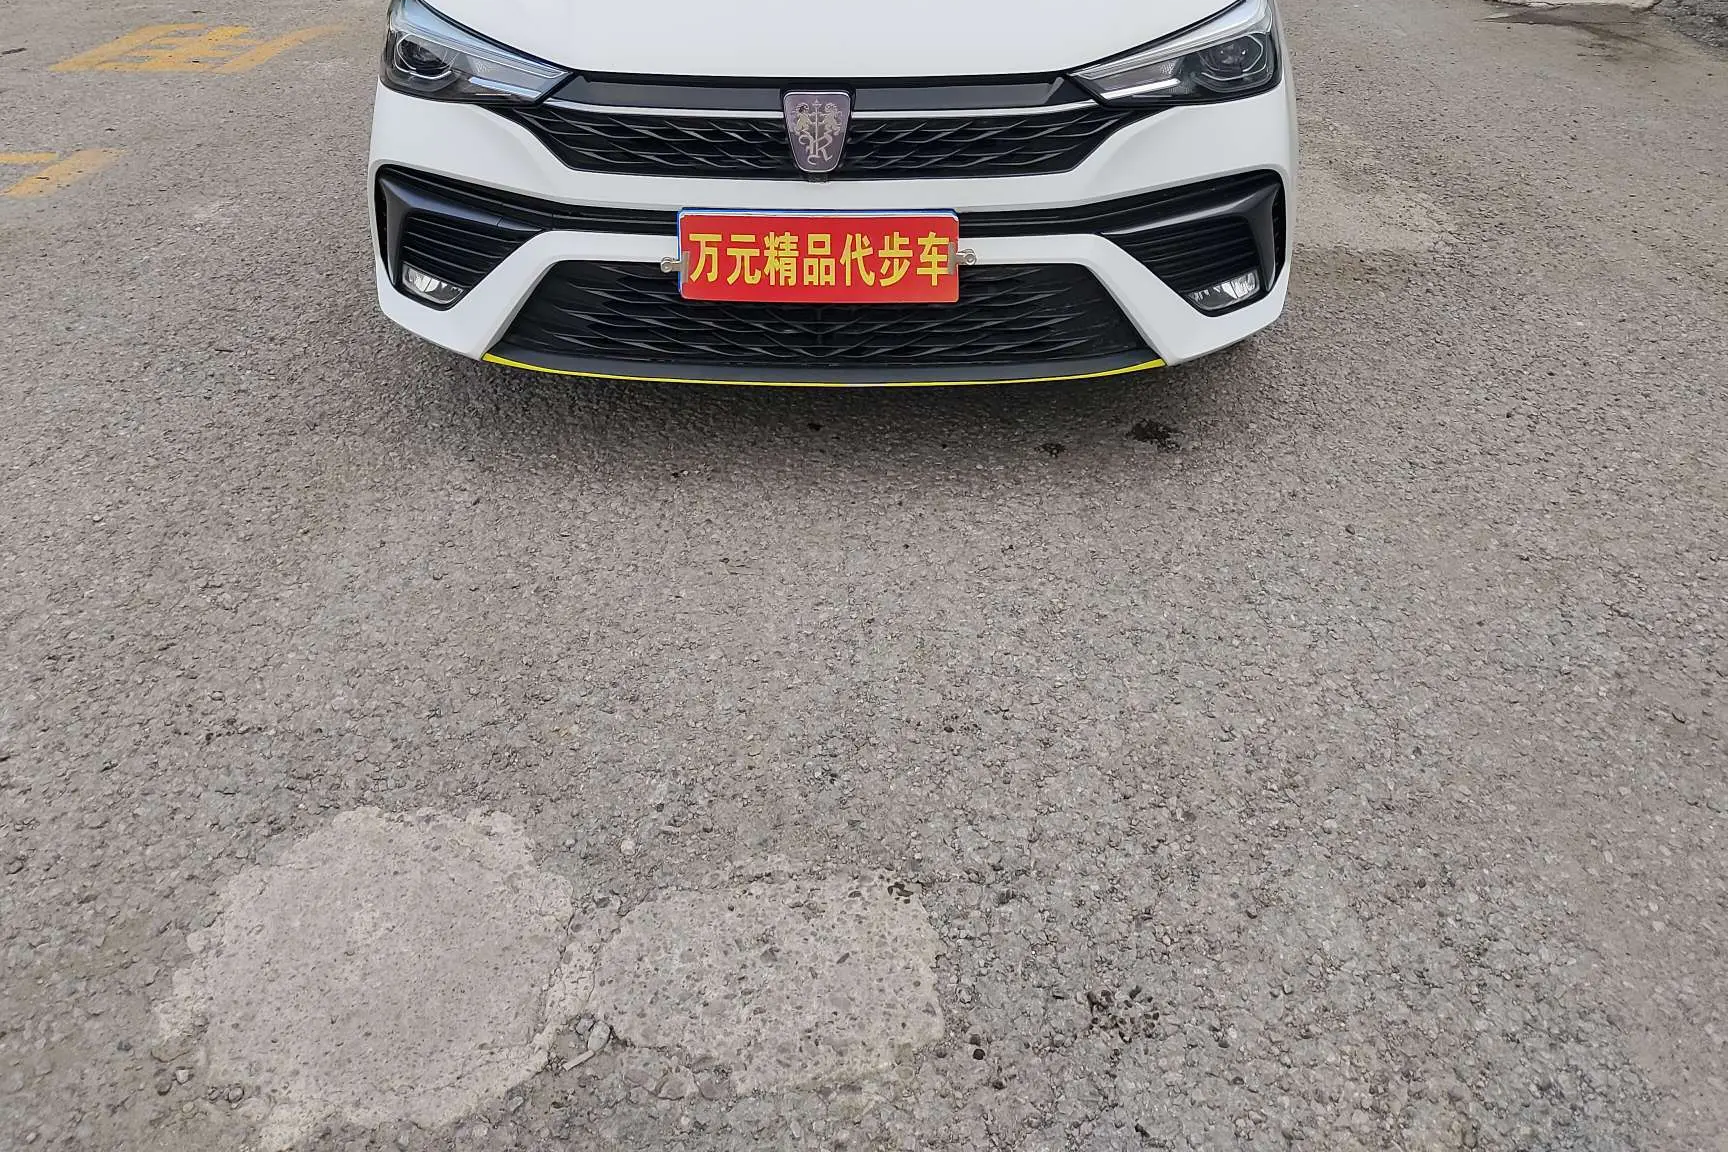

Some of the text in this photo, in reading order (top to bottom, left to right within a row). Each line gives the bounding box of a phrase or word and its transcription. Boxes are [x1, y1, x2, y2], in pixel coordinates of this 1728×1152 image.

[688, 231, 953, 287] 万元精品代步车
